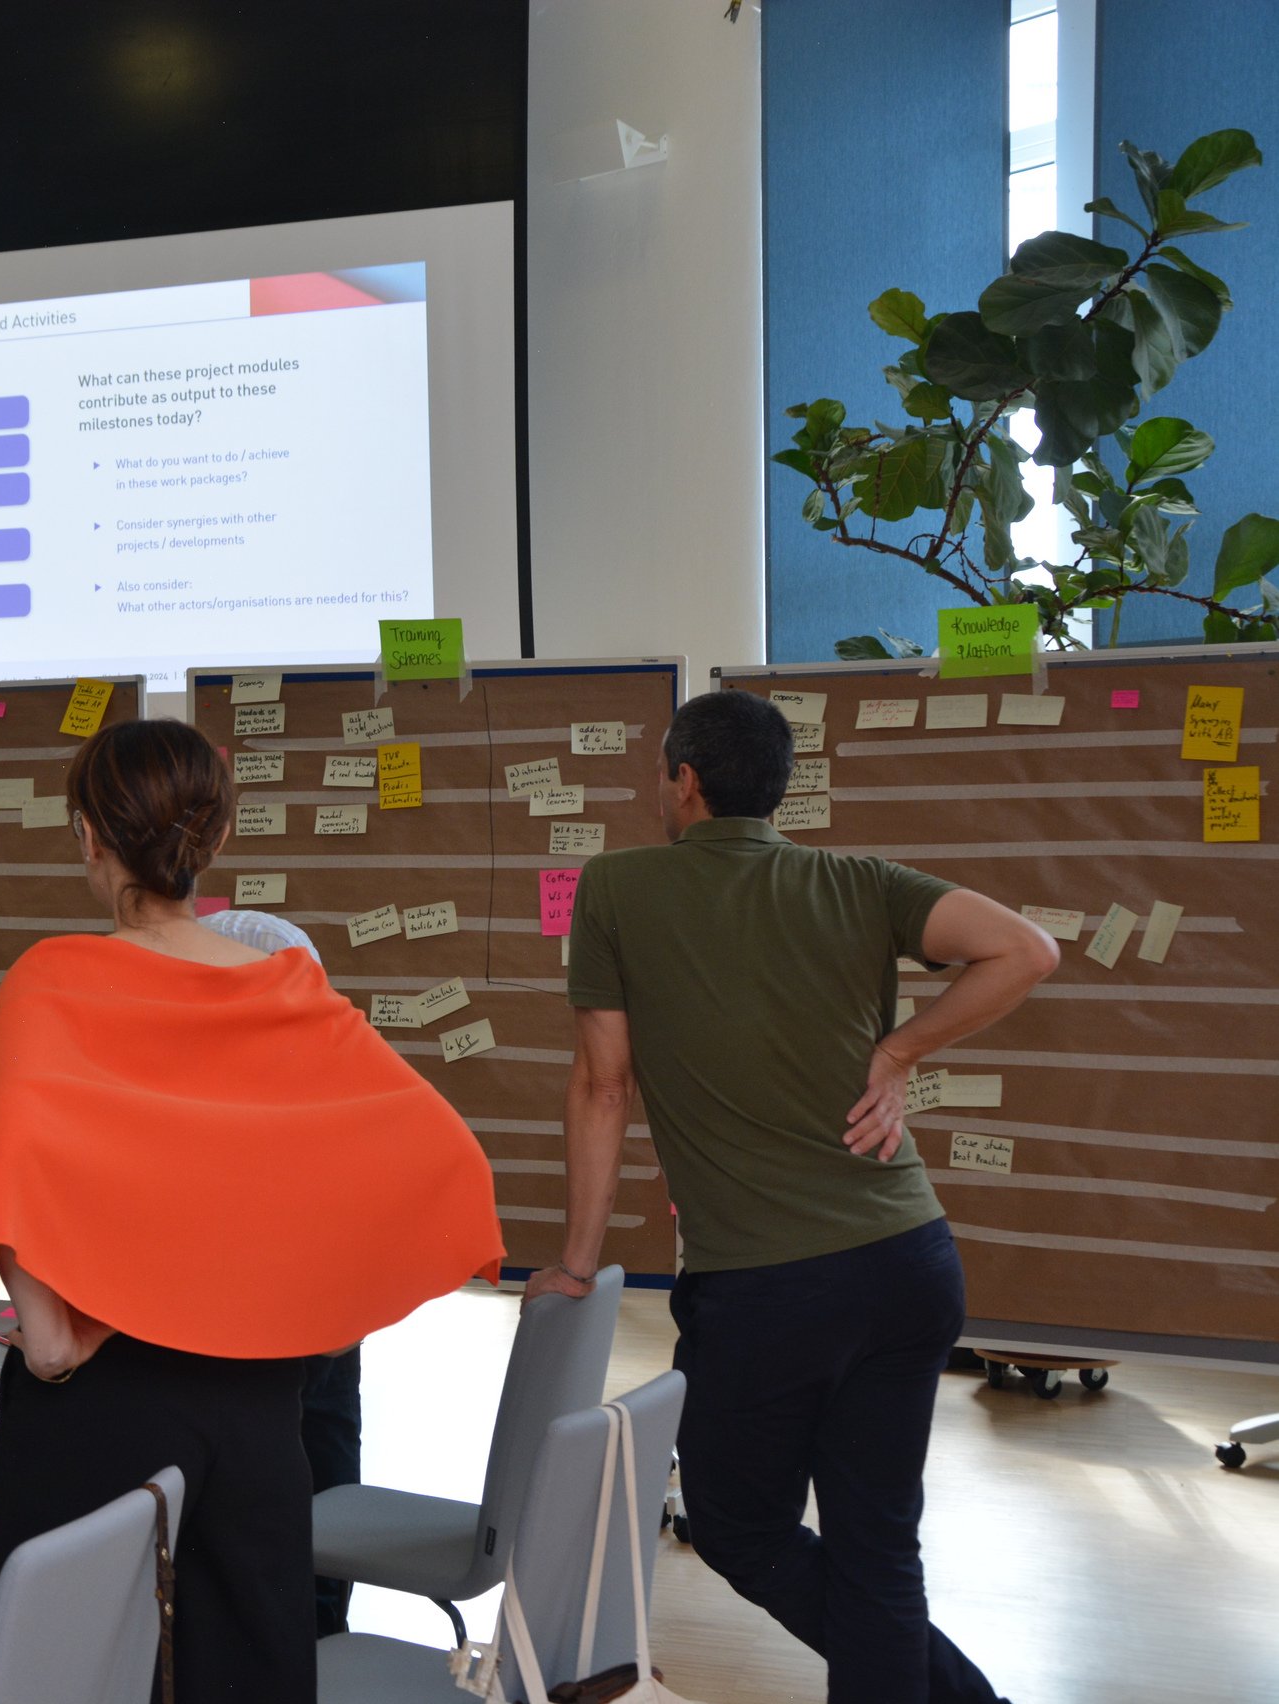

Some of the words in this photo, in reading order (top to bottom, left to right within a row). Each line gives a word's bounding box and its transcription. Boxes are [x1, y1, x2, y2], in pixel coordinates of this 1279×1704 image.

[11, 311, 77, 329] Activities
[78, 373, 113, 388] What
[116, 372, 140, 385] can
[144, 368, 181, 383] these
[186, 363, 234, 381] project
[238, 358, 300, 375] modules
[78, 393, 147, 410] contribute
[151, 393, 167, 404] as
[171, 387, 216, 403] output
[220, 386, 233, 398] to
[237, 382, 277, 397] these
[78, 414, 153, 431] milestones
[157, 409, 202, 427] today?
[115, 458, 143, 470] What
[145, 456, 159, 468] do
[161, 456, 180, 470] you
[183, 454, 208, 466] want
[211, 453, 223, 464] to
[225, 450, 238, 463] do
[248, 447, 290, 461] achieve
[116, 478, 126, 490] in
[128, 475, 158, 489] these
[160, 474, 187, 487] work
[190, 470, 248, 487] packages?
[116, 517, 164, 531] Consider
[167, 514, 218, 531] synergies
[221, 513, 245, 525] with
[247, 512, 277, 523] other
[116, 538, 160, 554] projects
[169, 534, 245, 550] developments
[116, 580, 140, 592] Also
[143, 578, 193, 591] consider:
[117, 601, 145, 613] What
[147, 599, 176, 611] other
[178, 594, 292, 612] actors/organisations
[294, 596, 313, 607] are
[316, 592, 359, 605] needed
[361, 591, 378, 603] for
[380, 589, 409, 603] this?
[389, 626, 446, 650] Training
[951, 616, 1020, 640] Knowledge
[389, 650, 442, 670] Schemes
[957, 642, 1014, 659] Platform
[547, 891, 562, 901] WS
[547, 909, 562, 919] WS
[455, 1032, 474, 1052] KP
[954, 1135, 979, 1148] Case
[952, 1150, 971, 1161] Best
